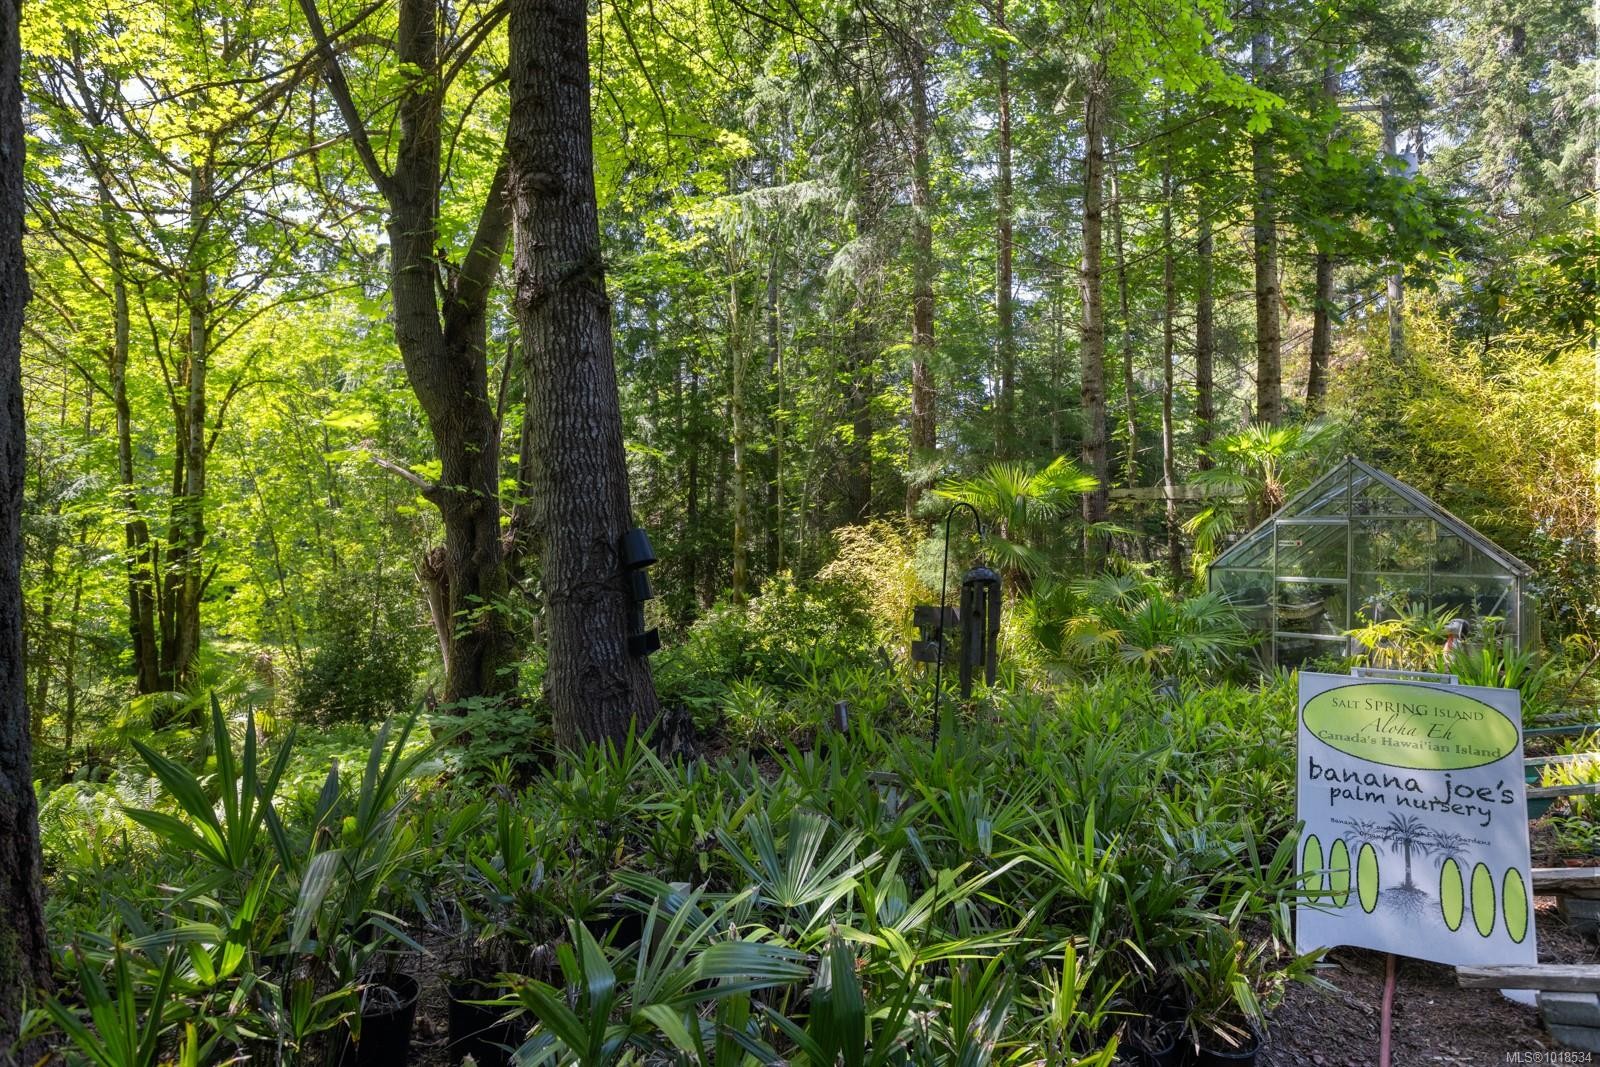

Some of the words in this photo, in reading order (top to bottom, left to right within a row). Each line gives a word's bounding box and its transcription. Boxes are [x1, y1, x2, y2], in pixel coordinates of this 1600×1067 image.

[1365, 699, 1428, 716] SPRING
[1361, 711, 1422, 737] Aloha
[1427, 715, 1468, 741] Eh
[1318, 730, 1377, 745] Canada's
[1455, 744, 1502, 758] Island
[1309, 756, 1423, 793] banana
[1441, 773, 1514, 804] joe's
[1330, 786, 1385, 806] palm
[1396, 795, 1491, 827] nursery
